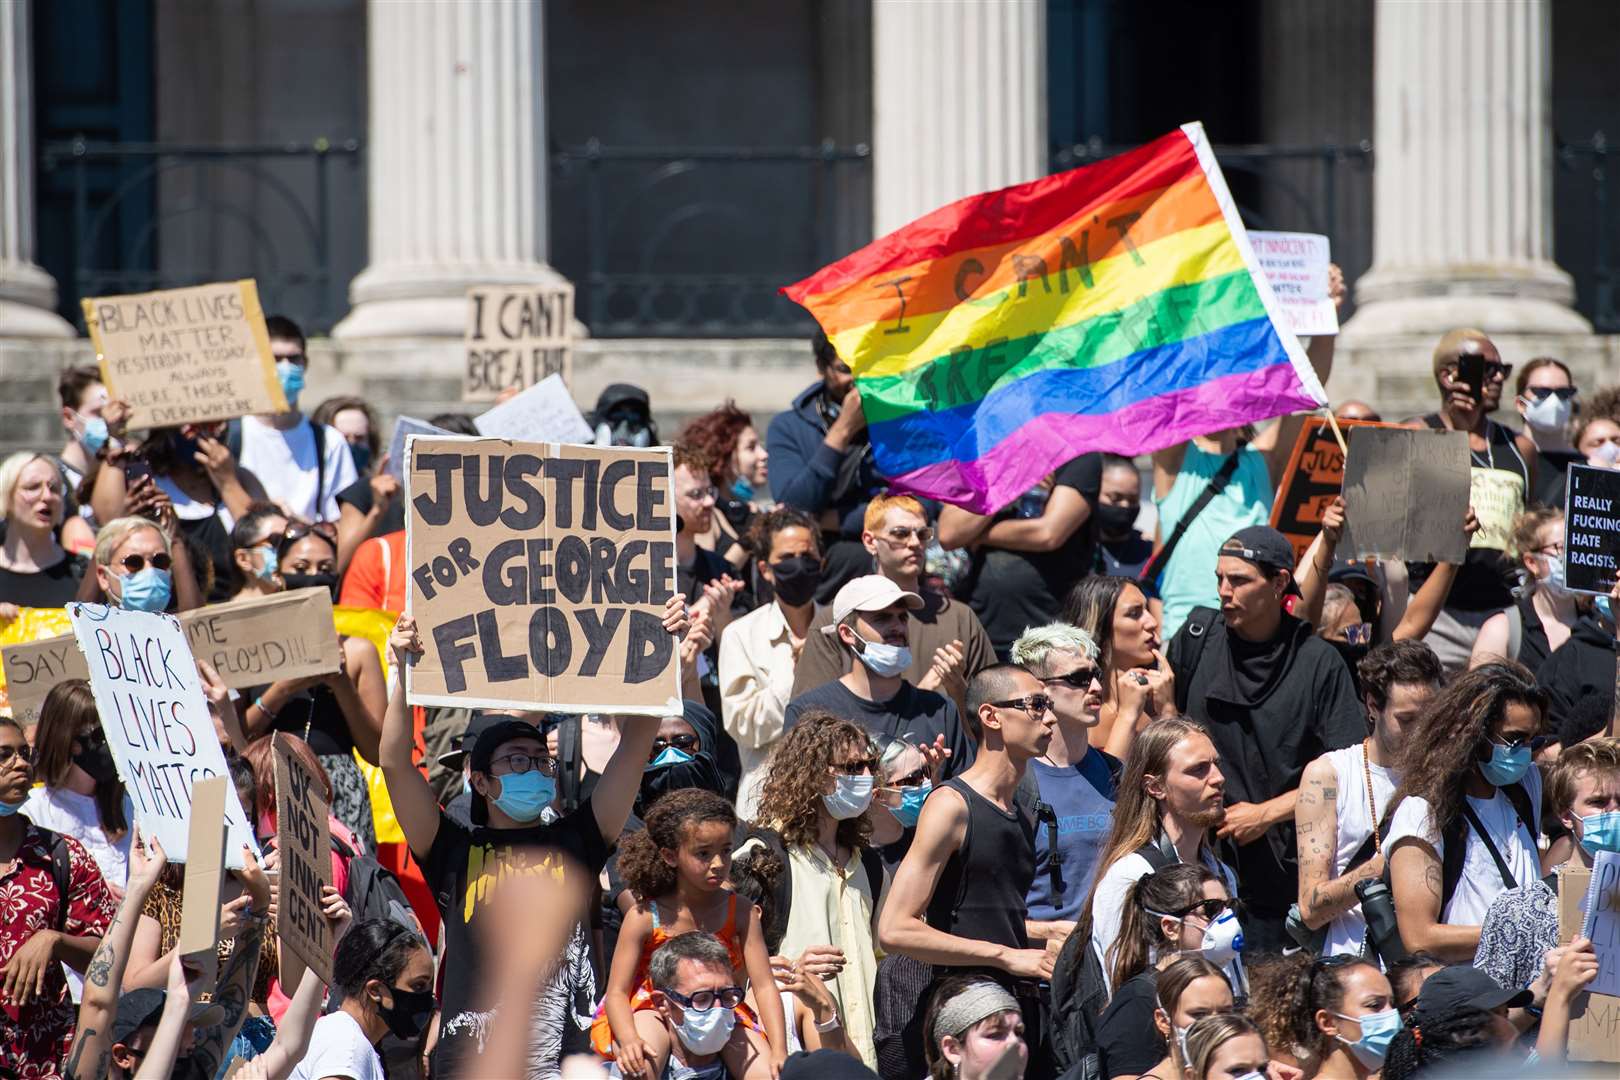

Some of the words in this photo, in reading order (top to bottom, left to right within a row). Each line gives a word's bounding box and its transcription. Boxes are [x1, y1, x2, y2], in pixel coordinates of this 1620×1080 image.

[98, 301, 177, 334] BLACK
[184, 294, 244, 324] LIVES
[473, 295, 486, 341] I
[138, 326, 234, 352] MATTER
[1307, 449, 1344, 473] JUS
[1574, 476, 1580, 489] I
[413, 453, 671, 531] JUSTICE
[1574, 495, 1613, 512] REALLY
[1570, 551, 1618, 569] RACISTS.
[1571, 532, 1601, 548] HATE
[412, 537, 480, 600] FOR
[482, 535, 674, 606] GEORGE
[9, 647, 68, 684] SAY
[95, 628, 186, 691] BLACK
[432, 606, 674, 694] FLOYD
[112, 691, 196, 757] LIVES
[286, 754, 316, 819] UK
[286, 795, 320, 859] NOT
[288, 887, 326, 949] CENT
